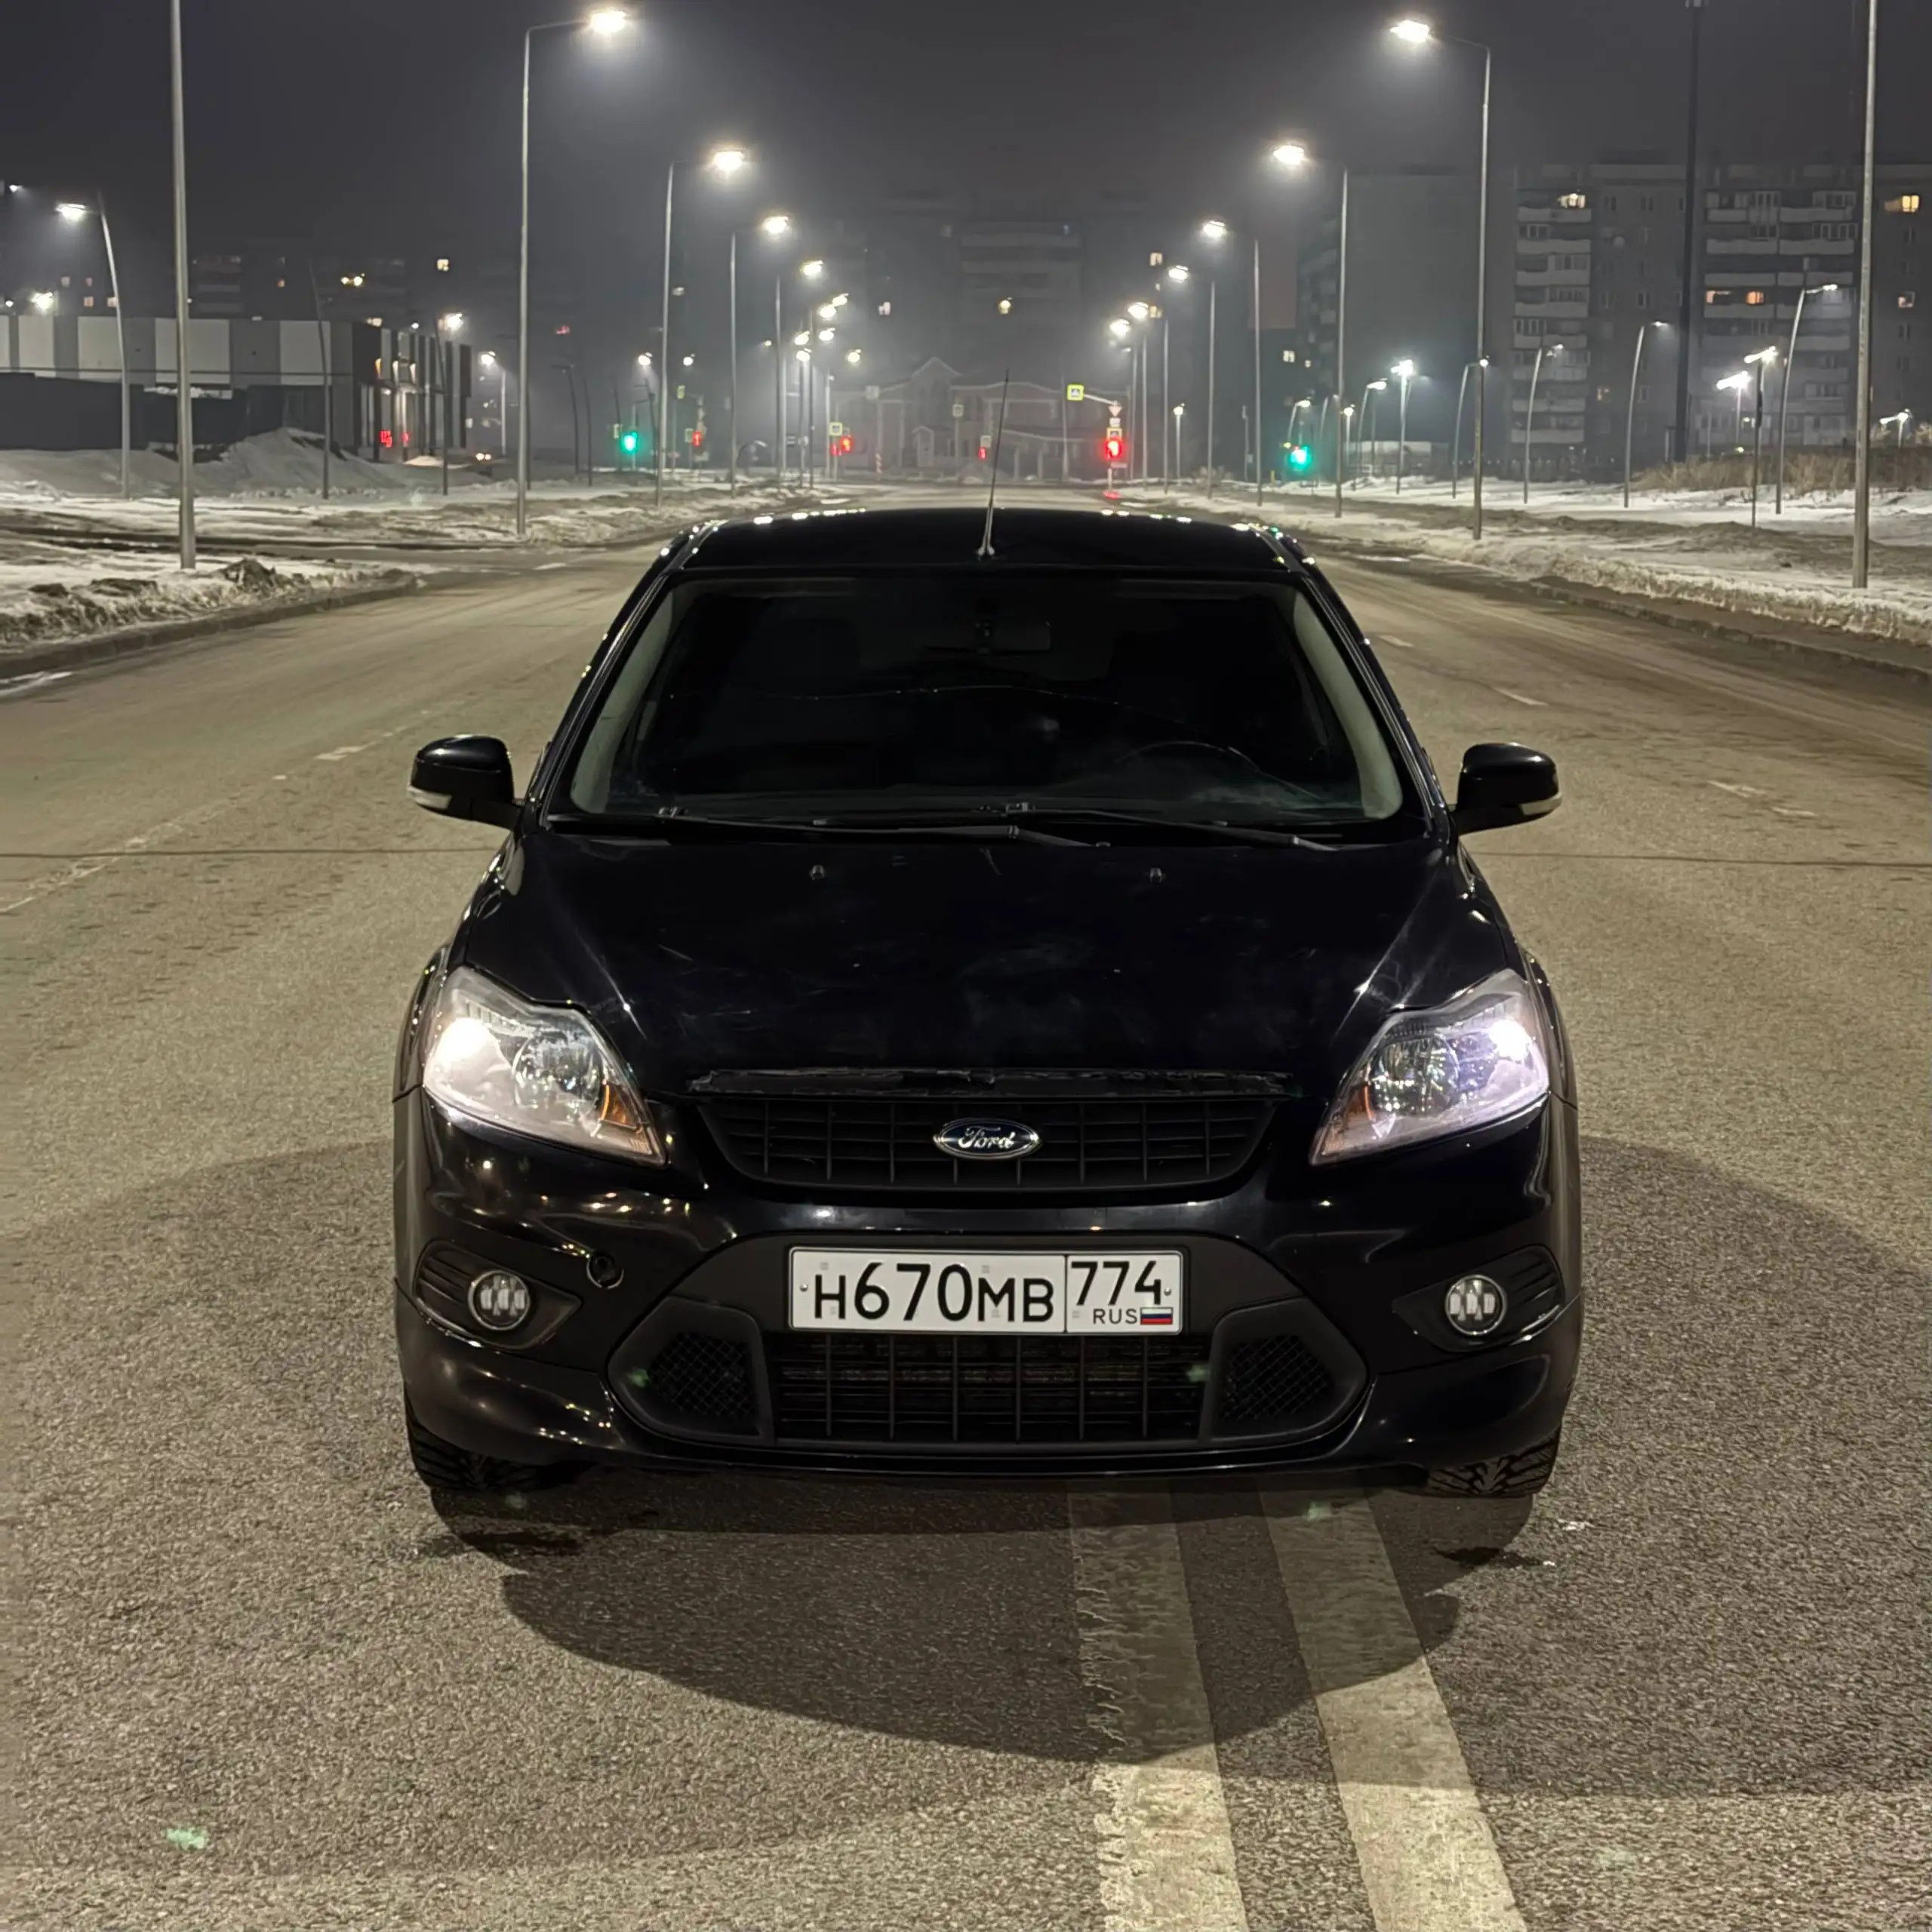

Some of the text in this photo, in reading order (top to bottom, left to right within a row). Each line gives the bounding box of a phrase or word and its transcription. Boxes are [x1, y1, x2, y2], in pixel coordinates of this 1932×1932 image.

[958, 1126, 1016, 1149] Ford
[1071, 1260, 1161, 1306] 774
[1093, 1308, 1138, 1325] RUS
